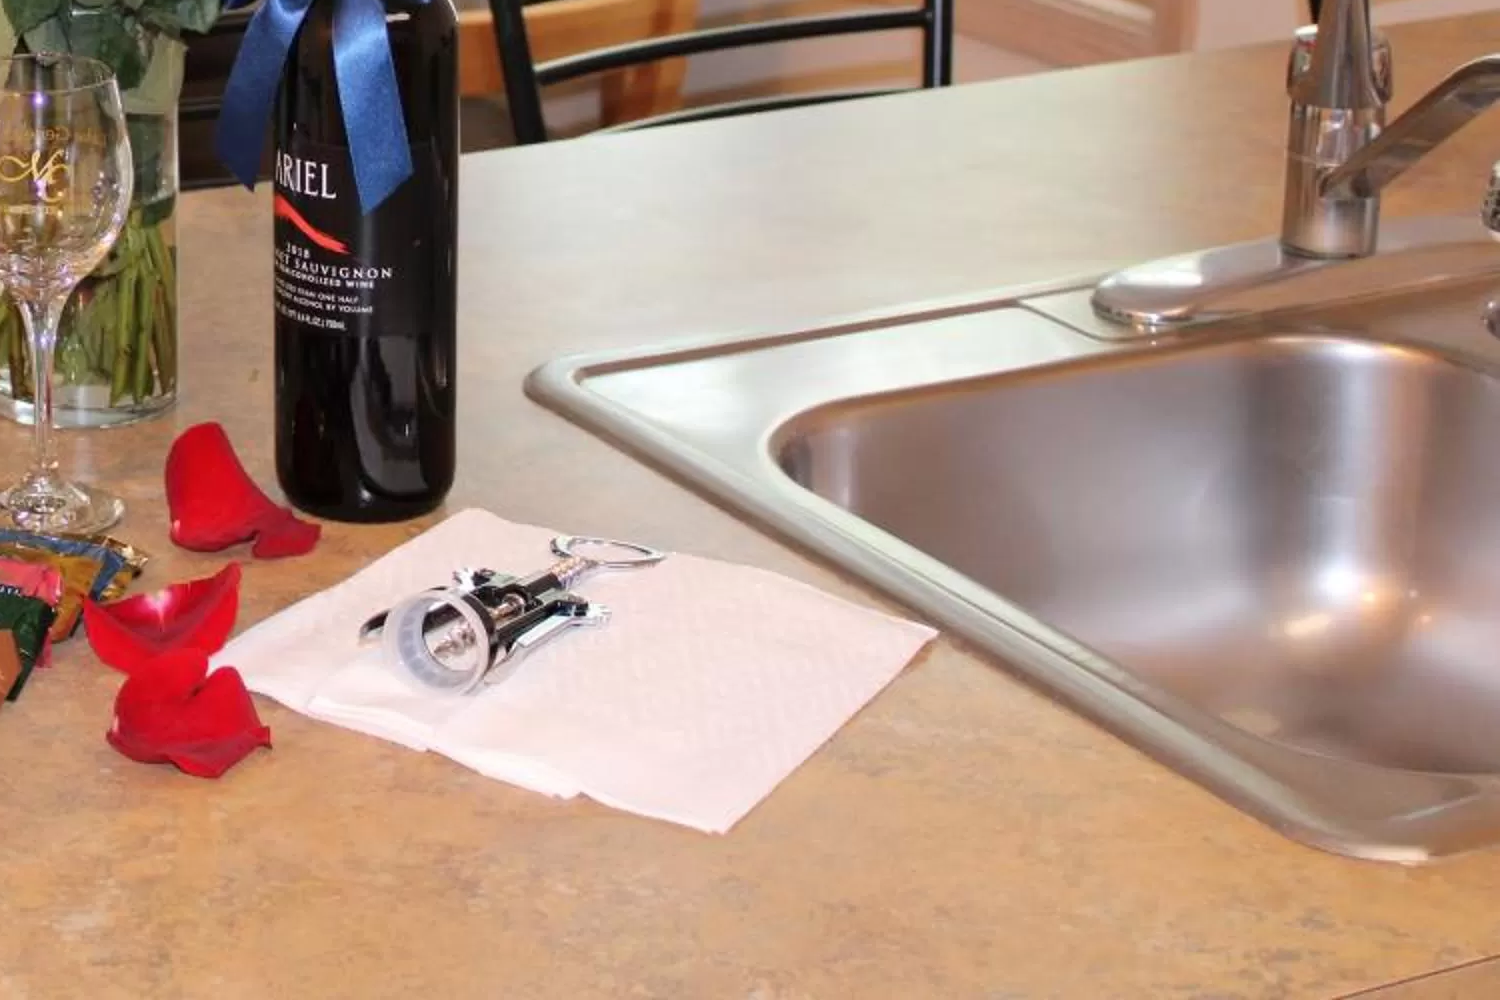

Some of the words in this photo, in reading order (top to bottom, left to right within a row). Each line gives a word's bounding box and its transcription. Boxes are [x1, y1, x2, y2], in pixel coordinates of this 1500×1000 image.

[275, 148, 337, 199] ARIEL
[294, 258, 393, 279] SAUVIGNON
[345, 280, 375, 290] WINE
